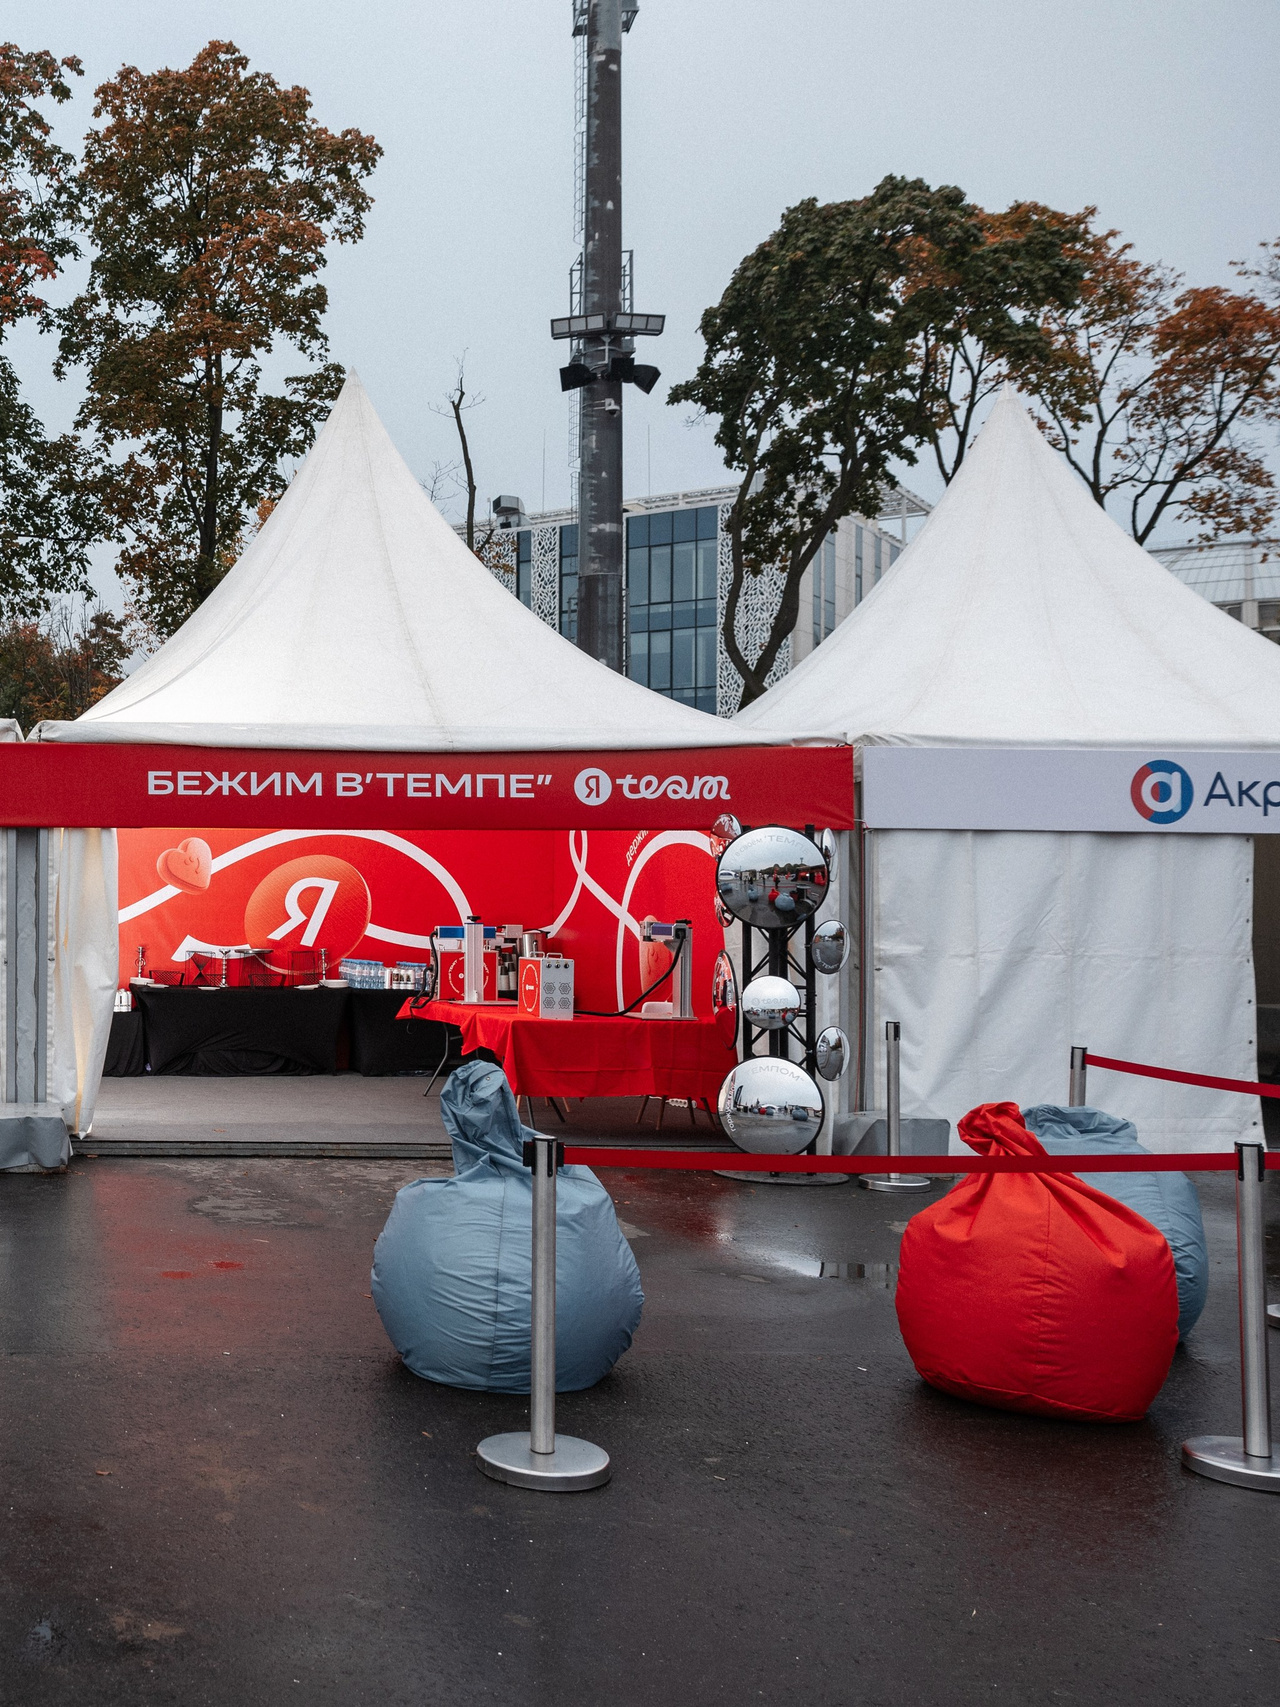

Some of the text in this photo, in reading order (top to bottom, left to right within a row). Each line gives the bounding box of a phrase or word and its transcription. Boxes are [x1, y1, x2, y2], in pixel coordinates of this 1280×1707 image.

[147, 770, 323, 797] БЕЖИМ
[615, 773, 731, 800] team
[1203, 771, 1280, 816] Акр
[625, 830, 649, 867] держи
